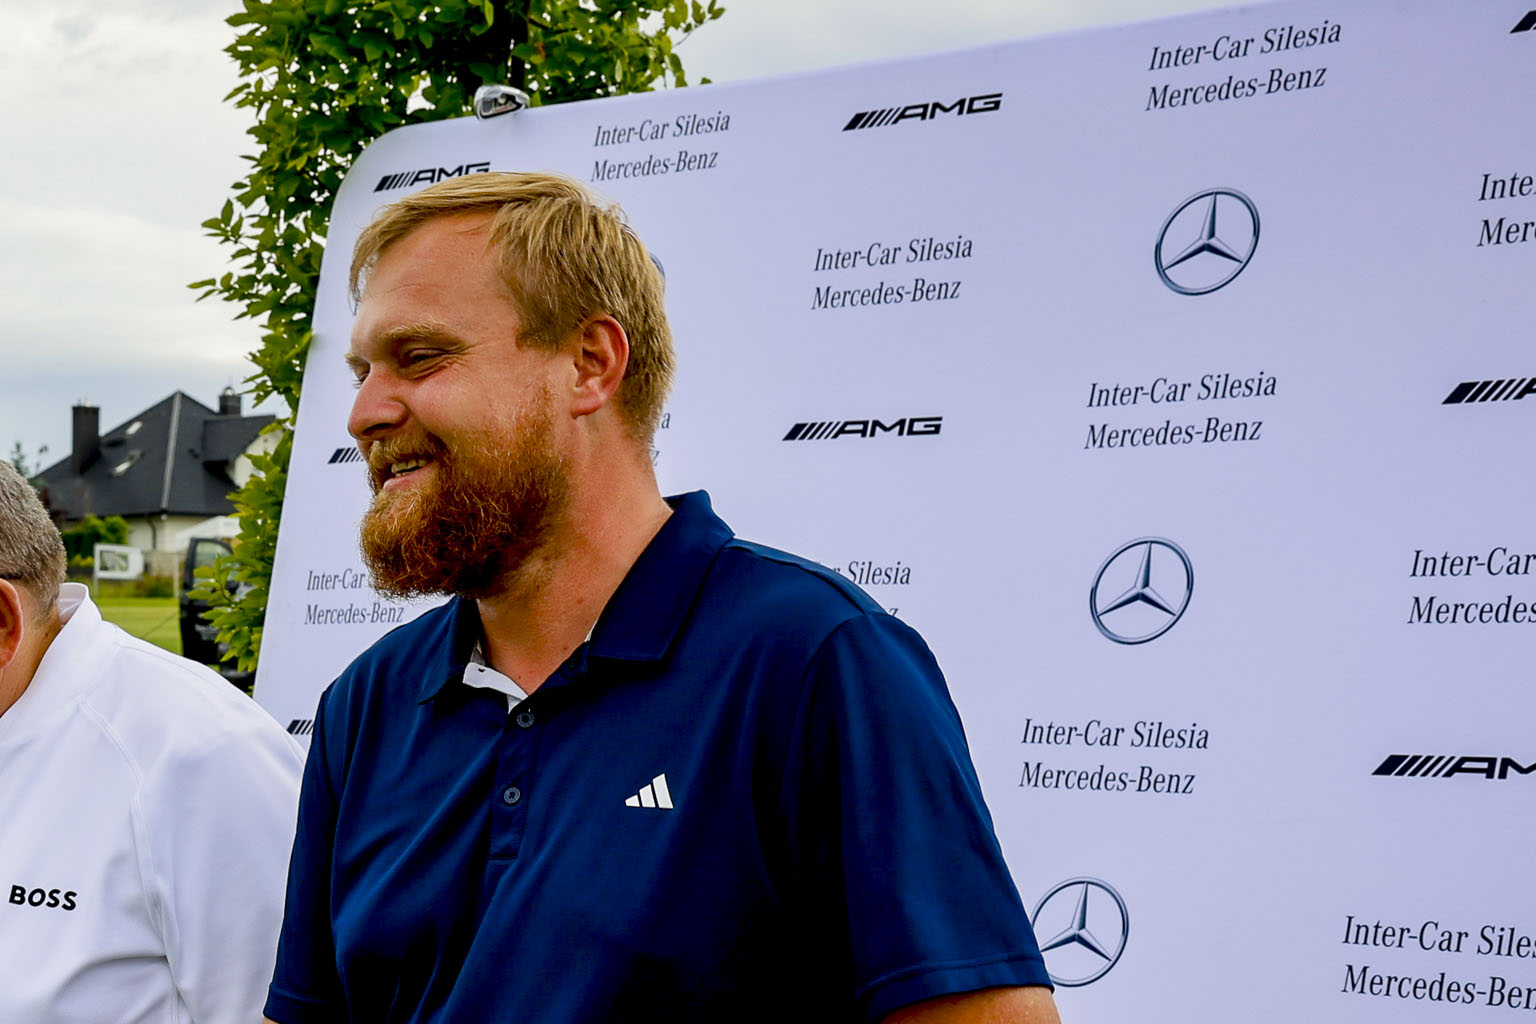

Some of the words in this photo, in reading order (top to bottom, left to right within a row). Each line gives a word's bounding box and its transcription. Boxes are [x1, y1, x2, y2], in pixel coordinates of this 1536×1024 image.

[1149, 36, 1254, 70] Inter-Car
[1261, 20, 1341, 53] Silesia
[1146, 65, 1327, 111] Mercedes-Benz
[891, 93, 1003, 125] AMG
[595, 120, 669, 146] Inter-Car
[676, 111, 730, 135] Silesia
[591, 150, 718, 181] Mercedes-Benz
[815, 243, 901, 271] Inter-Car
[906, 235, 972, 263] Silesia
[812, 278, 961, 309] Mercedes-Benz
[1088, 378, 1191, 407] Inter-Car
[1197, 371, 1276, 400] Silesia
[831, 416, 943, 439] AMG
[1084, 417, 1263, 449] Mercedes-Benz
[848, 560, 911, 585] Silesia
[1409, 546, 1536, 578] Inter-Car
[306, 567, 366, 591] Inter-Car
[304, 602, 405, 625] Mercedes-Benz
[1021, 719, 1125, 746] Inter-Car
[1131, 721, 1208, 749] Silesia
[1019, 762, 1195, 794] Mercedes-Benz
[8, 884, 78, 911] BOSS
[1342, 915, 1469, 953] Inter-Car
[1476, 925, 1536, 959] Sile
